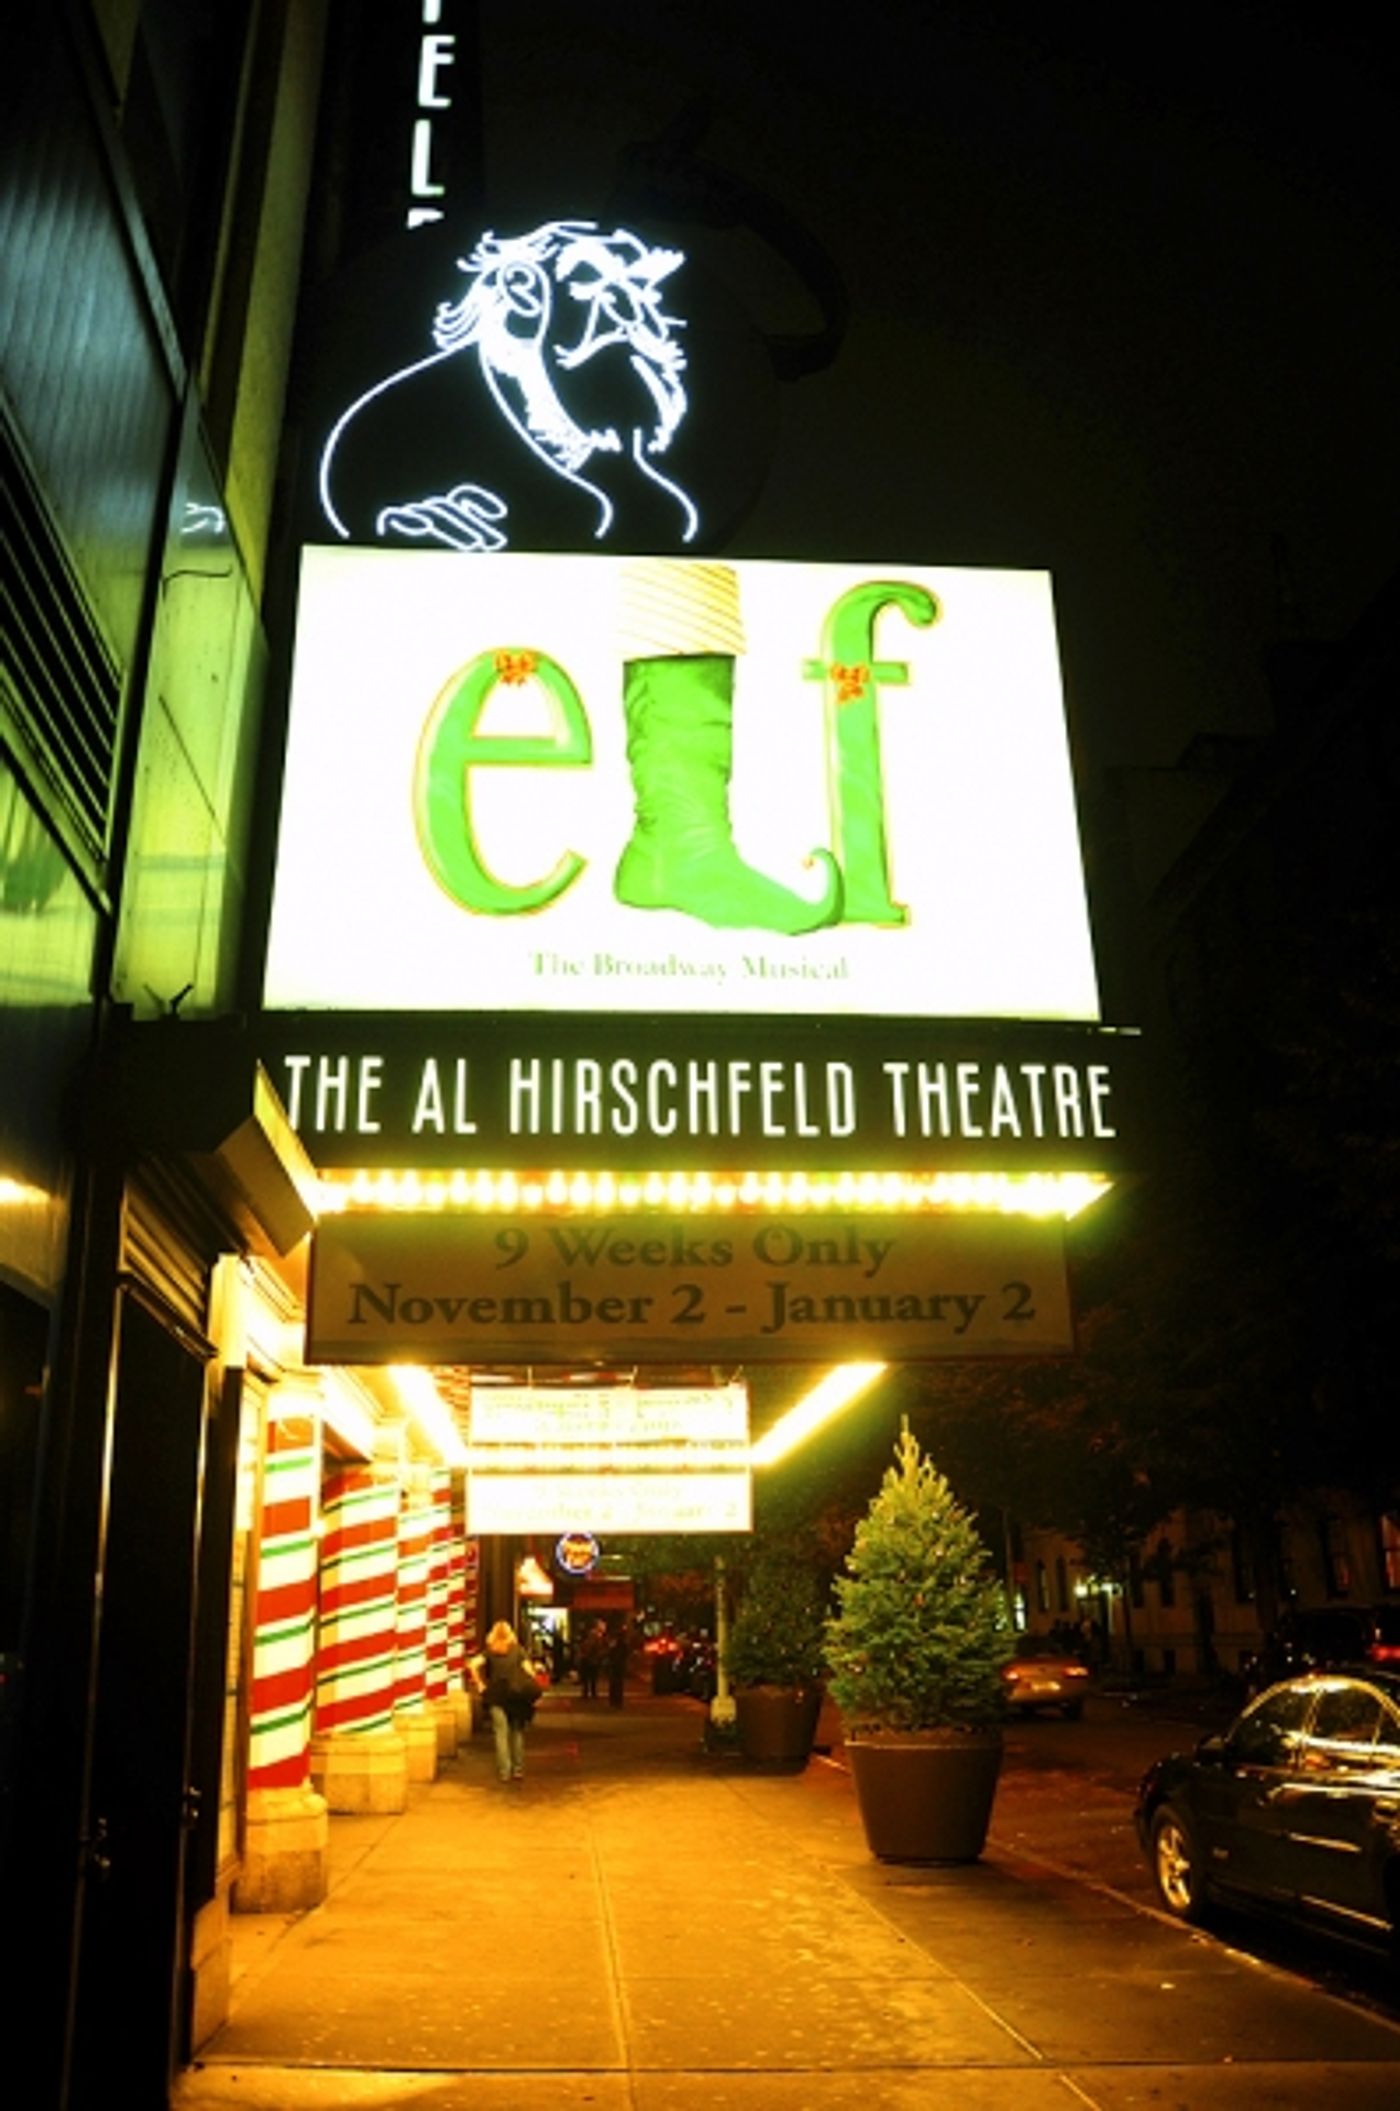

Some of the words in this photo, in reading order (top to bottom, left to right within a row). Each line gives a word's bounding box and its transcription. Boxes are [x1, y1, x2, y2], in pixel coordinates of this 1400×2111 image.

[408, 0, 456, 229] EL
[529, 951, 582, 977] The
[593, 953, 727, 985] Broadway
[742, 955, 849, 981] Musical
[284, 1055, 384, 1133] THE
[412, 1057, 478, 1134] AL
[509, 1057, 857, 1137] HIRSCHFELD
[883, 1061, 1117, 1138] THEATRE
[493, 1227, 530, 1271] 9
[547, 1222, 734, 1268] Weeks
[753, 1223, 897, 1279] Only
[347, 1280, 654, 1325] November
[669, 1283, 707, 1324] 2
[760, 1281, 987, 1334] January
[1001, 1281, 1036, 1321] 2
